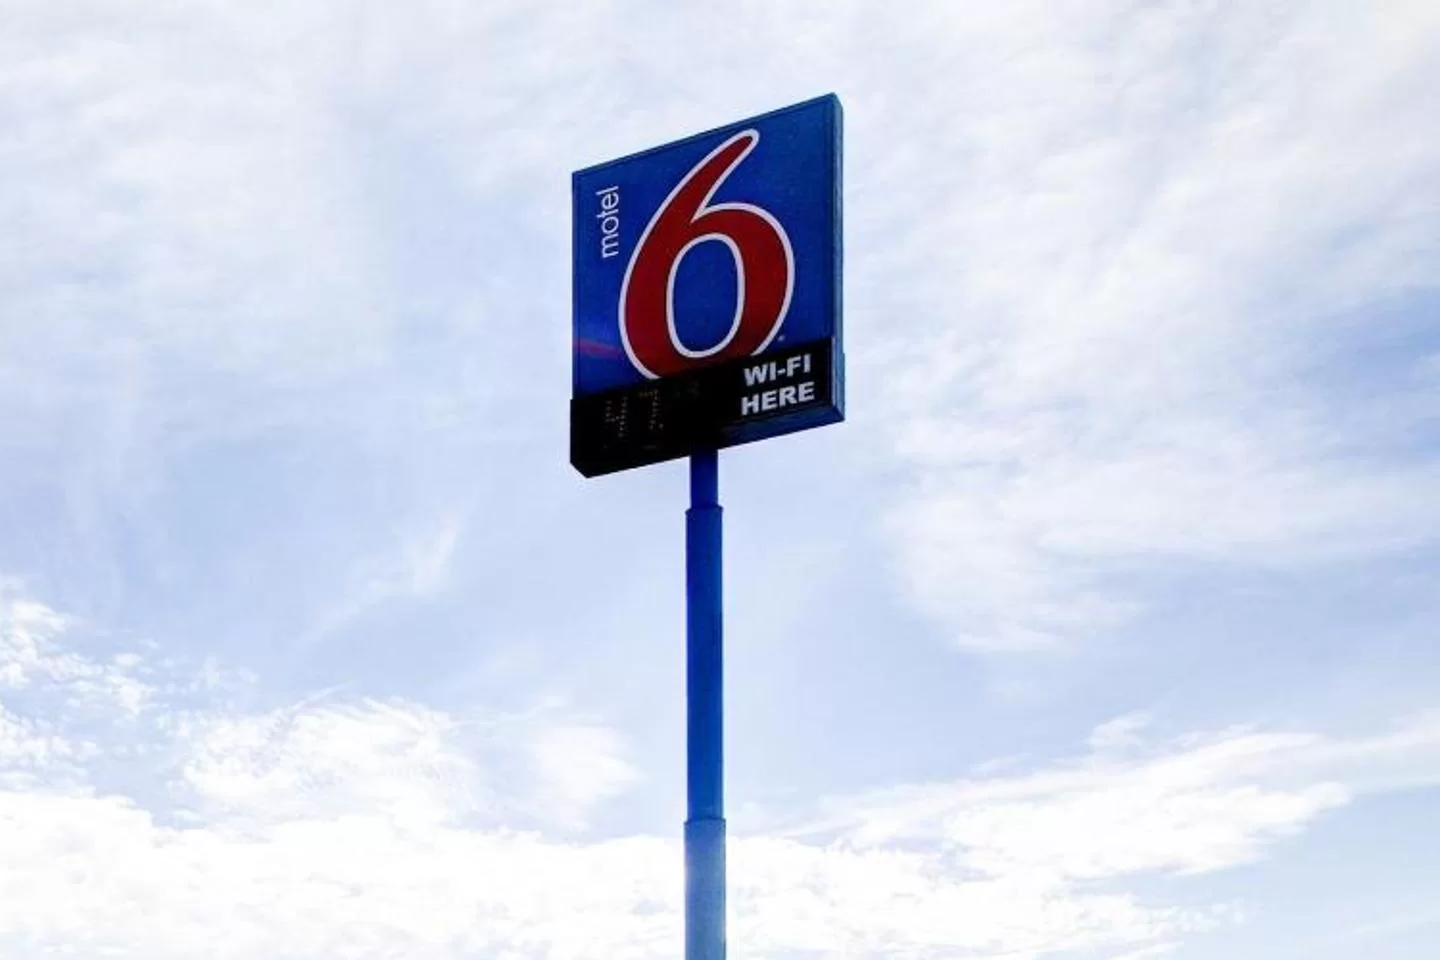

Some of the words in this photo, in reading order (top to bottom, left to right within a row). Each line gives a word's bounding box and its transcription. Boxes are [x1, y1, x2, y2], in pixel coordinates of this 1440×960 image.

[596, 185, 619, 258] motel
[618, 128, 796, 380] 6
[743, 353, 812, 387] WI-FI
[741, 382, 816, 416] HERE
